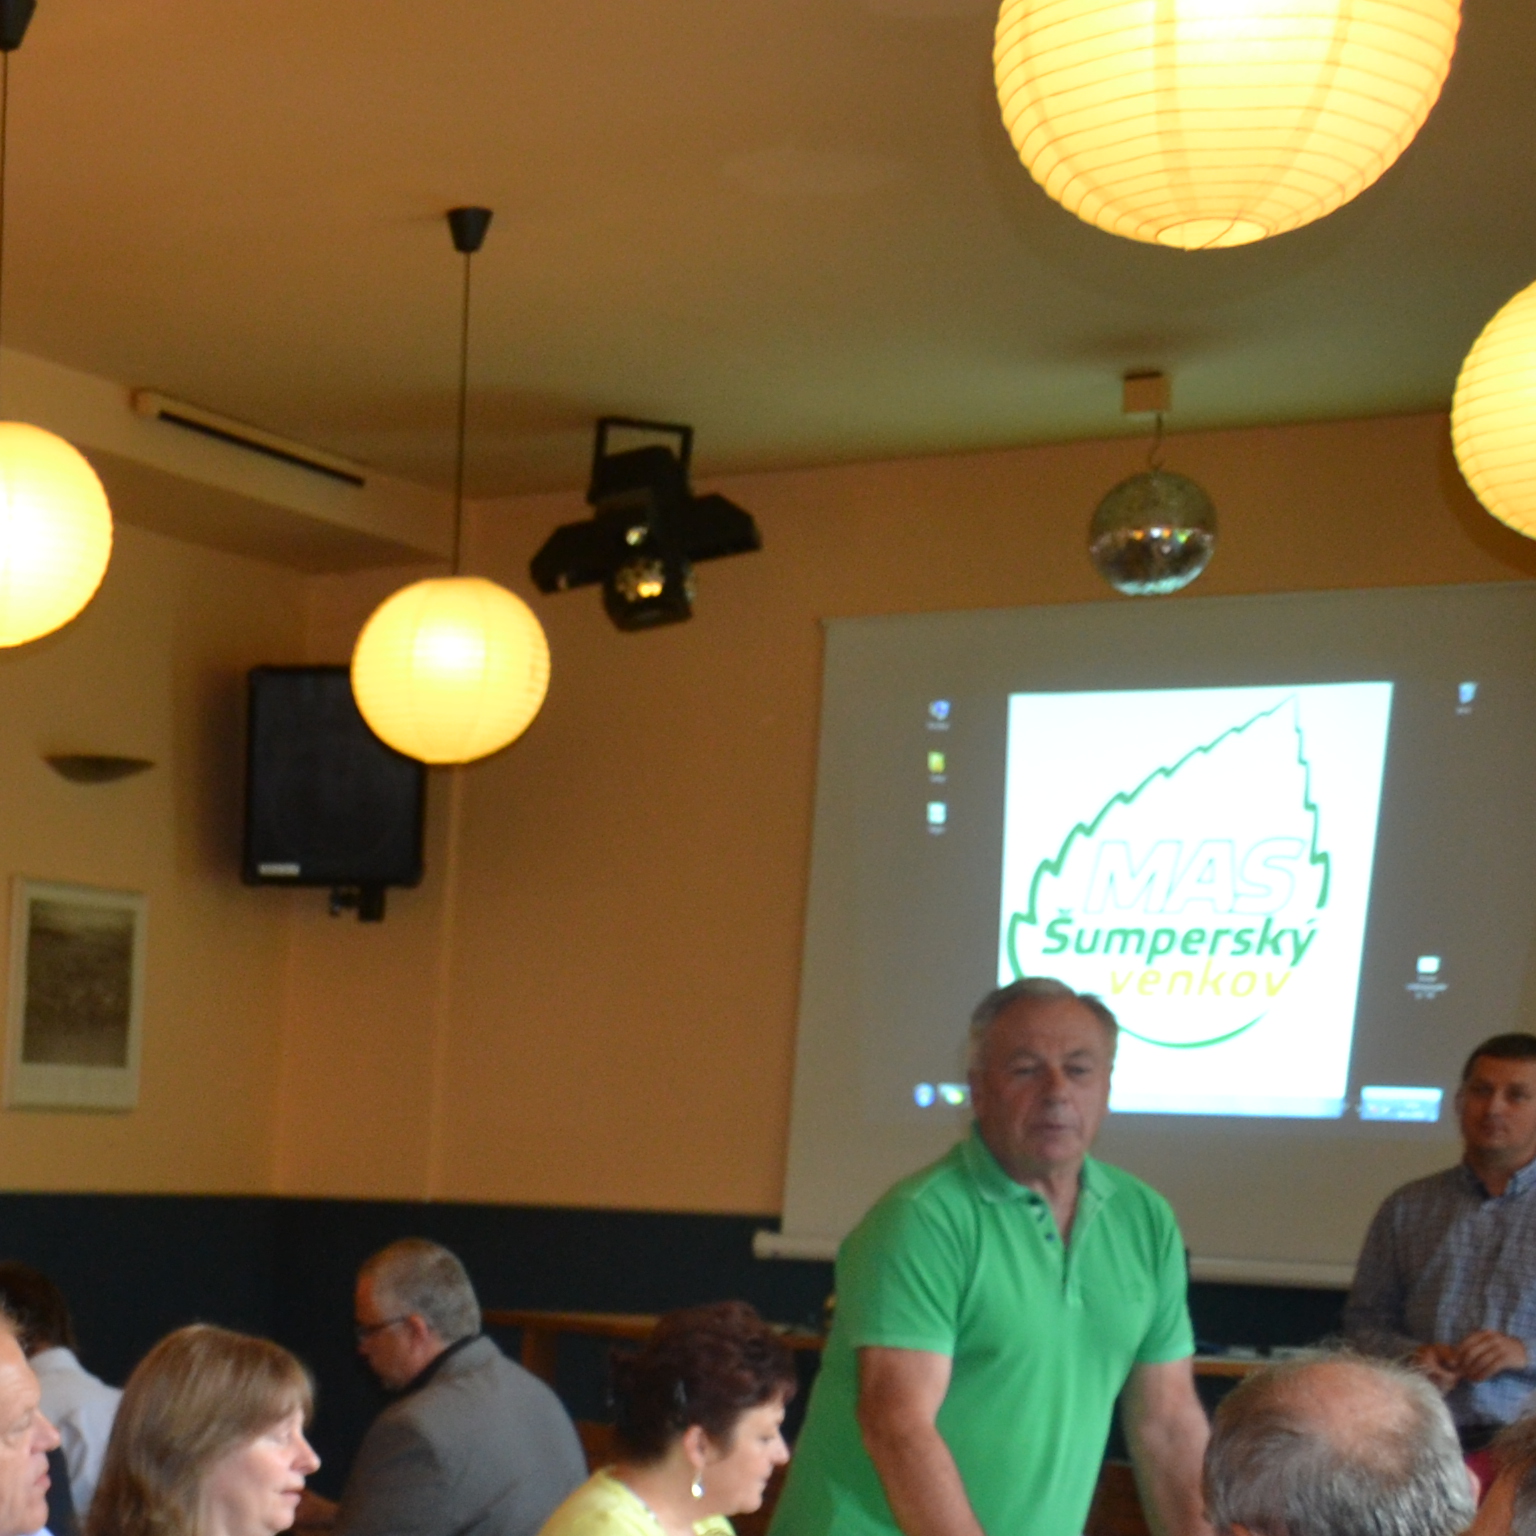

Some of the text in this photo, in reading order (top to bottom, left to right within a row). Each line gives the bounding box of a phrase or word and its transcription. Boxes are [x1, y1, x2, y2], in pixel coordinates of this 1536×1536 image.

[1083, 836, 1308, 915] MAS
[1042, 907, 1318, 967] Šumperský
[1110, 958, 1291, 997] venkov
